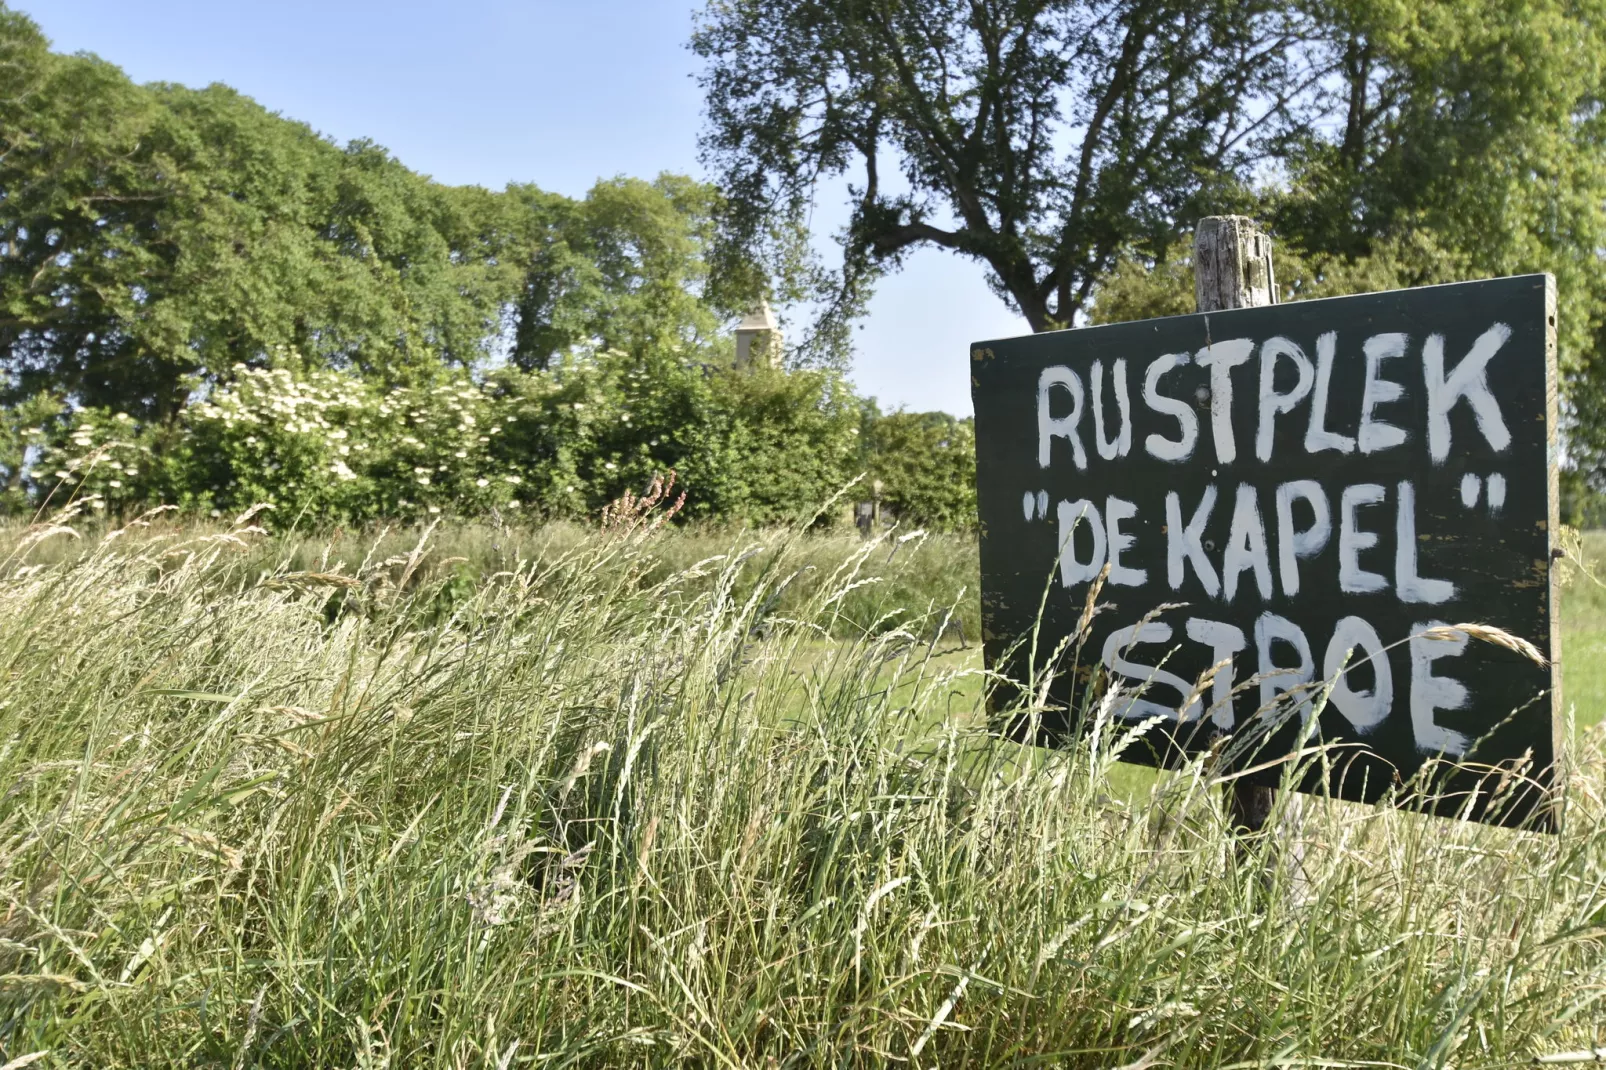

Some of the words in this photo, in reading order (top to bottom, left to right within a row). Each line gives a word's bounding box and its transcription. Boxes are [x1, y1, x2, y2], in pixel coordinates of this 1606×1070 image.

[1036, 321, 1512, 470] RUSTPLEK
[1022, 489, 1148, 589] "DE
[1165, 472, 1507, 605] KAPEL"
[1101, 611, 1474, 757] STROE
